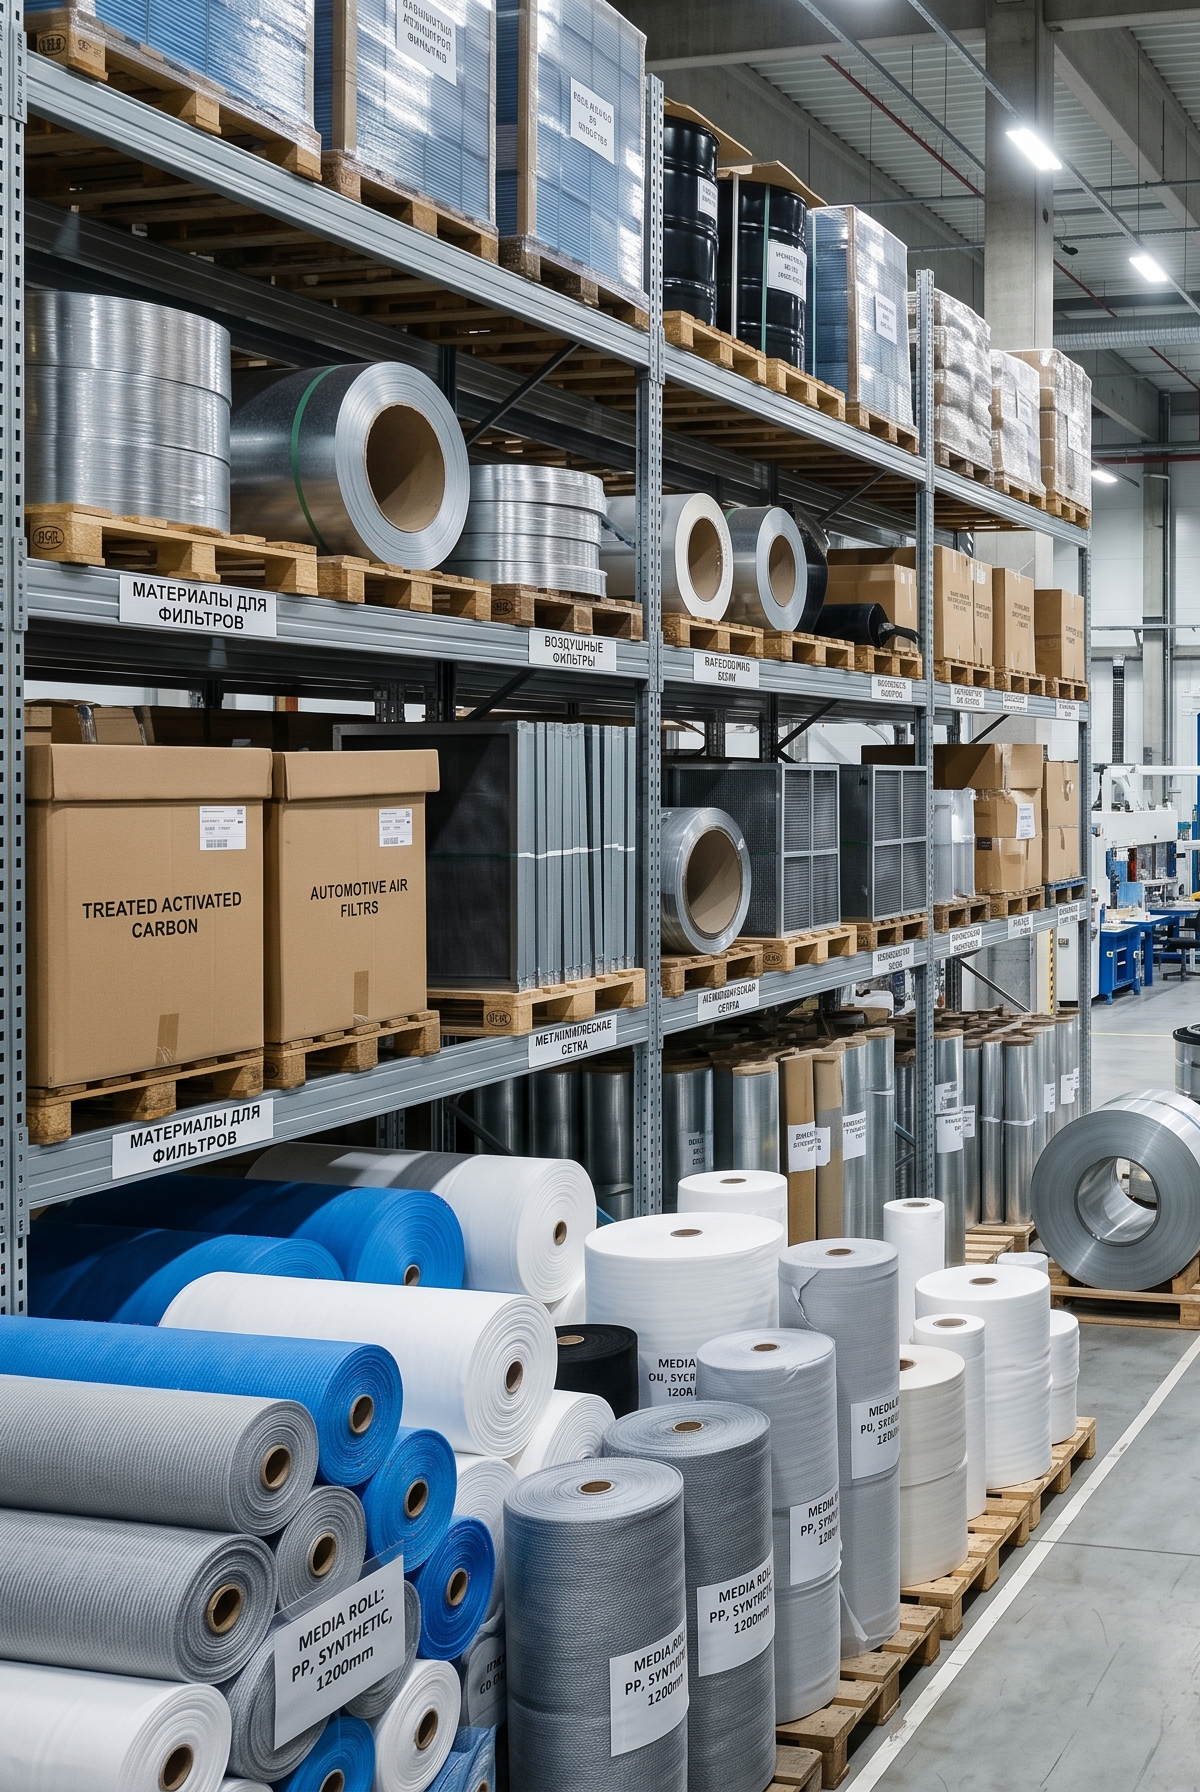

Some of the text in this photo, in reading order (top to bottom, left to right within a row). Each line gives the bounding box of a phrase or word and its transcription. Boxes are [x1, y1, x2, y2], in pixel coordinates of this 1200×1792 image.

[133, 582, 267, 612] МАТЕРИАЛЫ ДЛЯ
[158, 606, 244, 630] ФИЛЬТРОВ
[310, 878, 408, 900] AUTOMOTIVE AIR
[82, 892, 242, 918] TREATED ACTIVATED
[340, 900, 379, 918] FILTRS
[131, 918, 198, 938] CARBON
[130, 1105, 260, 1148] МАТЕРИАЛЫ ДЛЯ
[152, 1130, 237, 1164] ФИЛЬТРОВ
[658, 1358, 696, 1368] MEDIA
[800, 1524, 816, 1536] PP,
[719, 1580, 755, 1603] MEDIA
[299, 1589, 384, 1652] MEDIA ROLL:
[710, 1610, 730, 1624] PP,
[292, 1608, 392, 1683] PP, SYNTHETIC,
[316, 1646, 374, 1692] 1200mm
[634, 1644, 671, 1672] MEDIA
[626, 1679, 645, 1696] PP,
